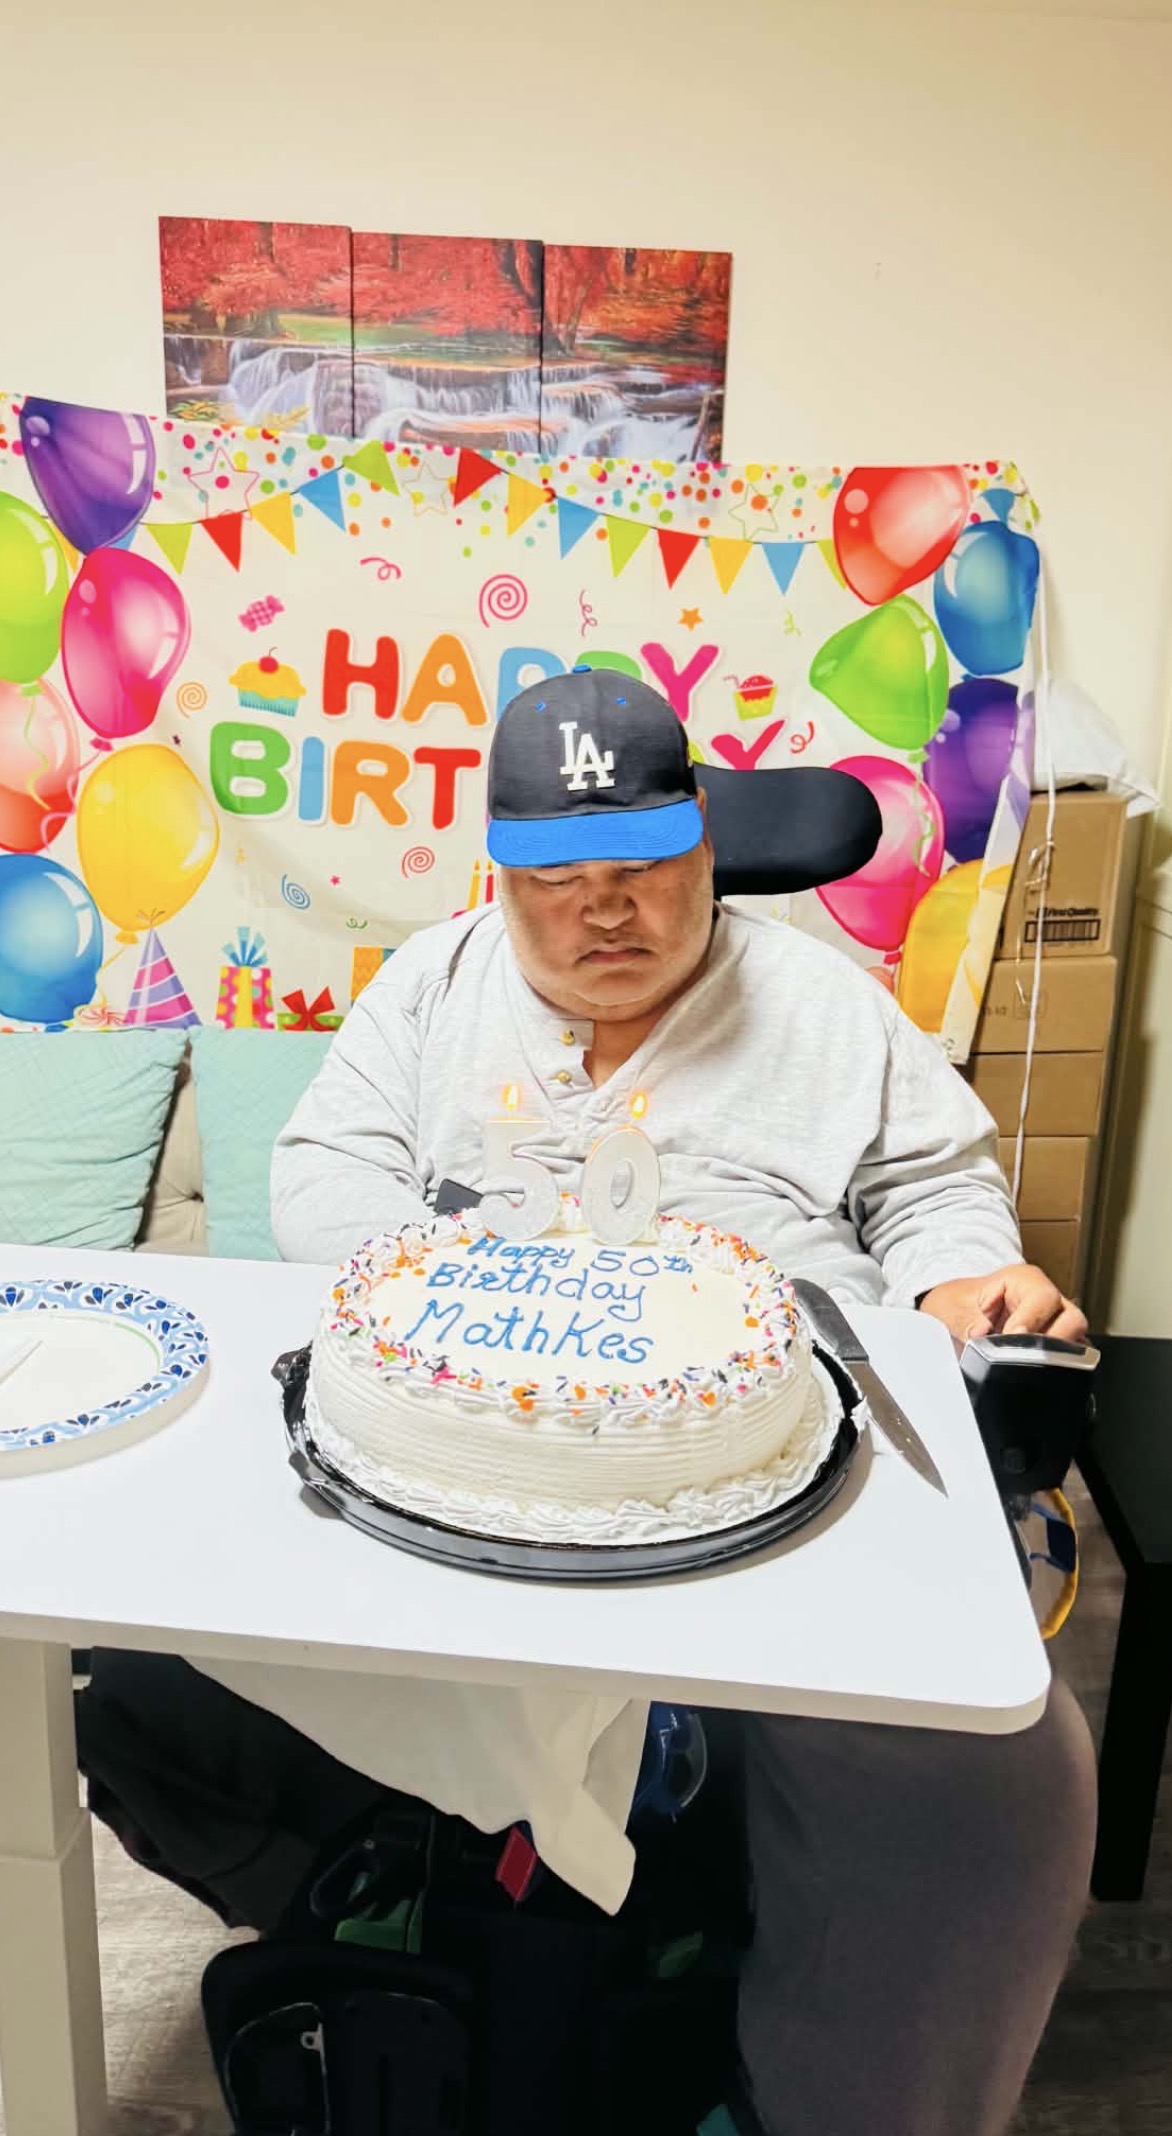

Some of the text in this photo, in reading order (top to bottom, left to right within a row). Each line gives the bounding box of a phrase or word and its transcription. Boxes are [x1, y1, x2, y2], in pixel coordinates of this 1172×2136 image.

[559, 721, 615, 791] LA
[479, 1120, 661, 1246] 50
[467, 1236, 694, 1277] Happy 50th
[426, 1261, 647, 1323] Birthday
